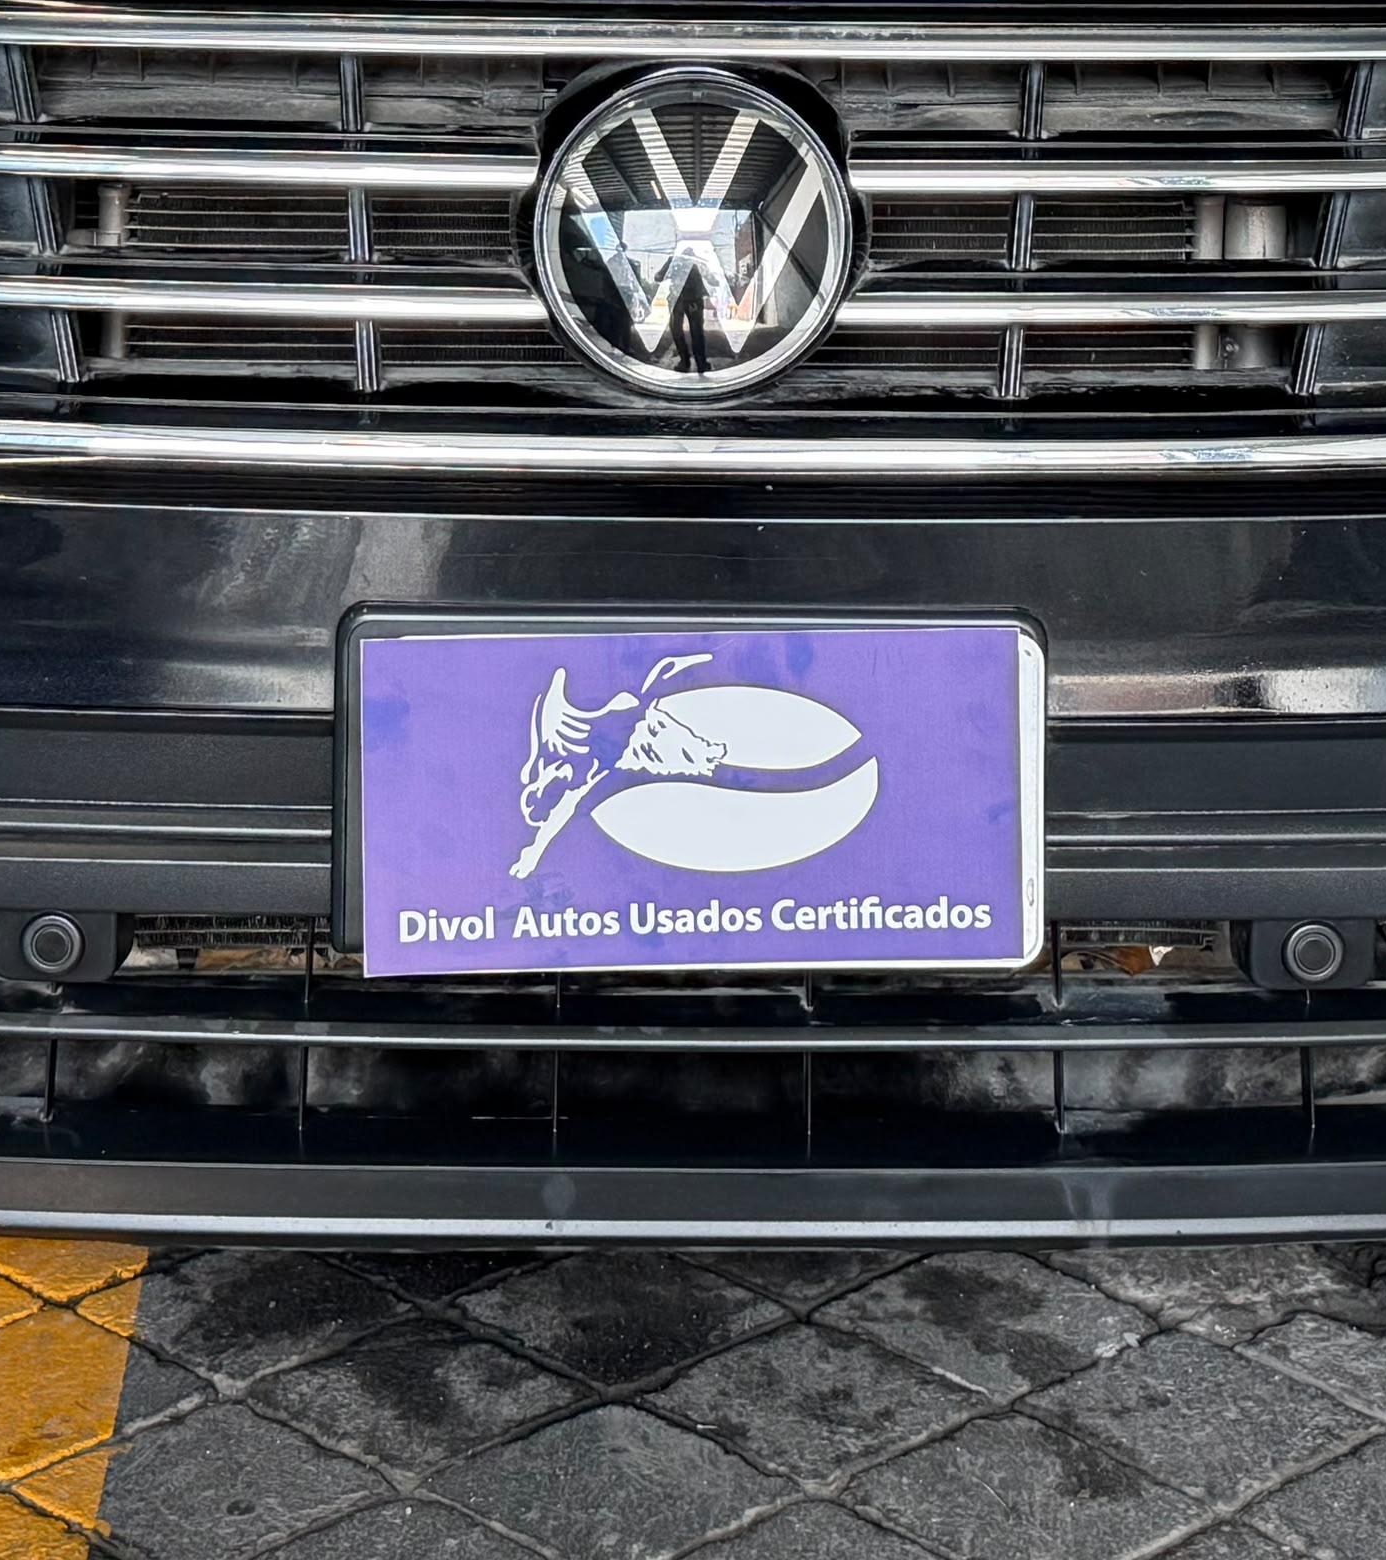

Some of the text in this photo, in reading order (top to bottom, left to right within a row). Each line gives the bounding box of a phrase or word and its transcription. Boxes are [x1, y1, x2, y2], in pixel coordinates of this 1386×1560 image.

[398, 895, 992, 943] Divol Autos Usados Certificados
